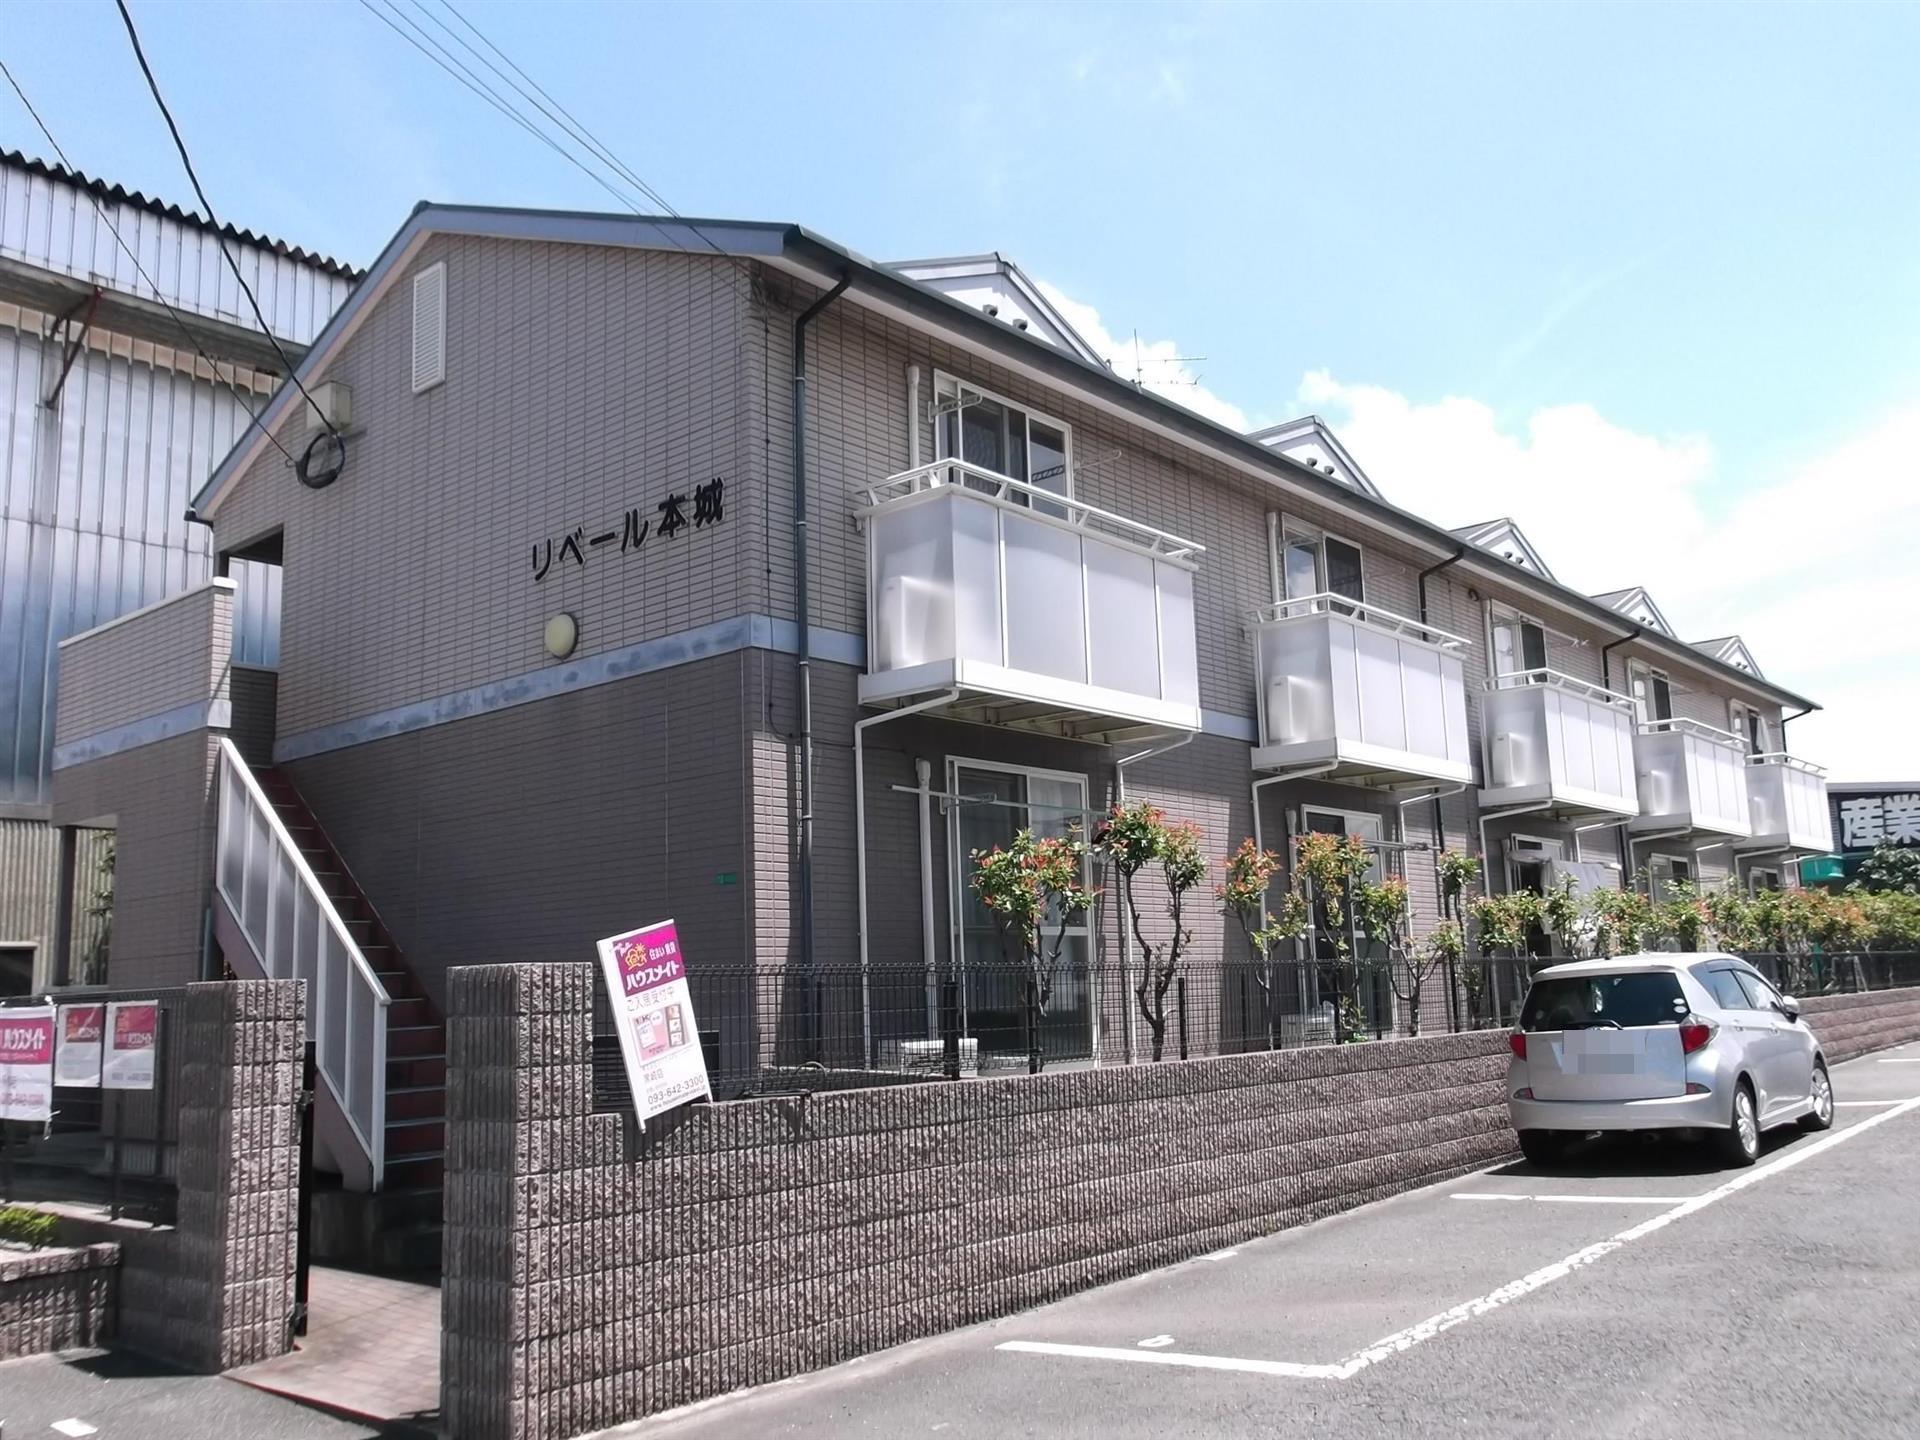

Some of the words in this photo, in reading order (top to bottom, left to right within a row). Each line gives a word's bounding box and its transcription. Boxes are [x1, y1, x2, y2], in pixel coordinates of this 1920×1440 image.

[533, 477, 723, 581] リベール本城
[1841, 794, 1920, 847] 産業
[626, 960, 680, 991] ハウスメイト
[648, 1075, 704, 1105] 093-642-3300
